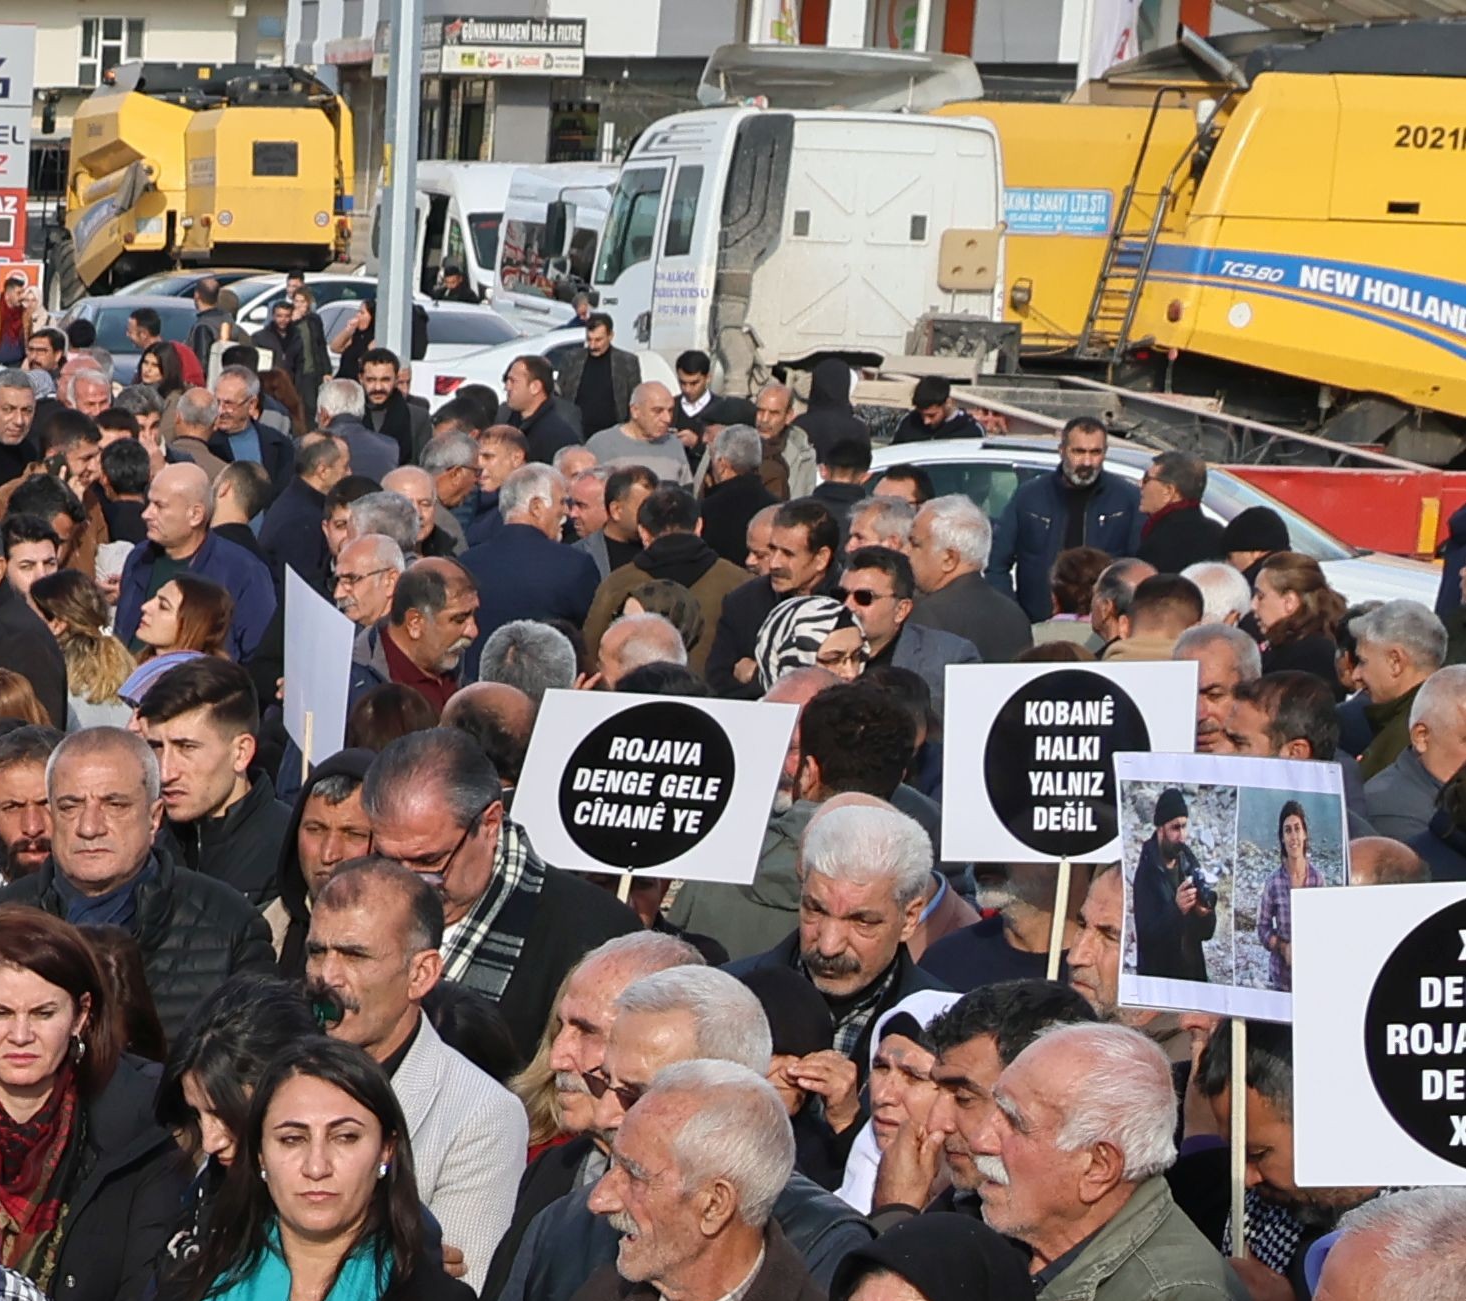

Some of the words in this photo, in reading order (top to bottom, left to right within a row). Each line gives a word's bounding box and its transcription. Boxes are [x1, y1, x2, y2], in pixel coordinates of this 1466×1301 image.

[461, 18, 496, 41] GÜNHAN
[1299, 264, 1360, 298] NEW
[1025, 694, 1115, 726] KOBANÊ
[608, 736, 703, 766] ROJAVA
[1035, 735, 1101, 762] HALKI
[572, 767, 655, 797] DENGE
[659, 776, 722, 802] GELE
[1029, 770, 1104, 798] YALNIZ
[673, 808, 703, 834] YE
[1032, 800, 1098, 833] DEĞİL
[1386, 1022, 1466, 1055] ROJA
